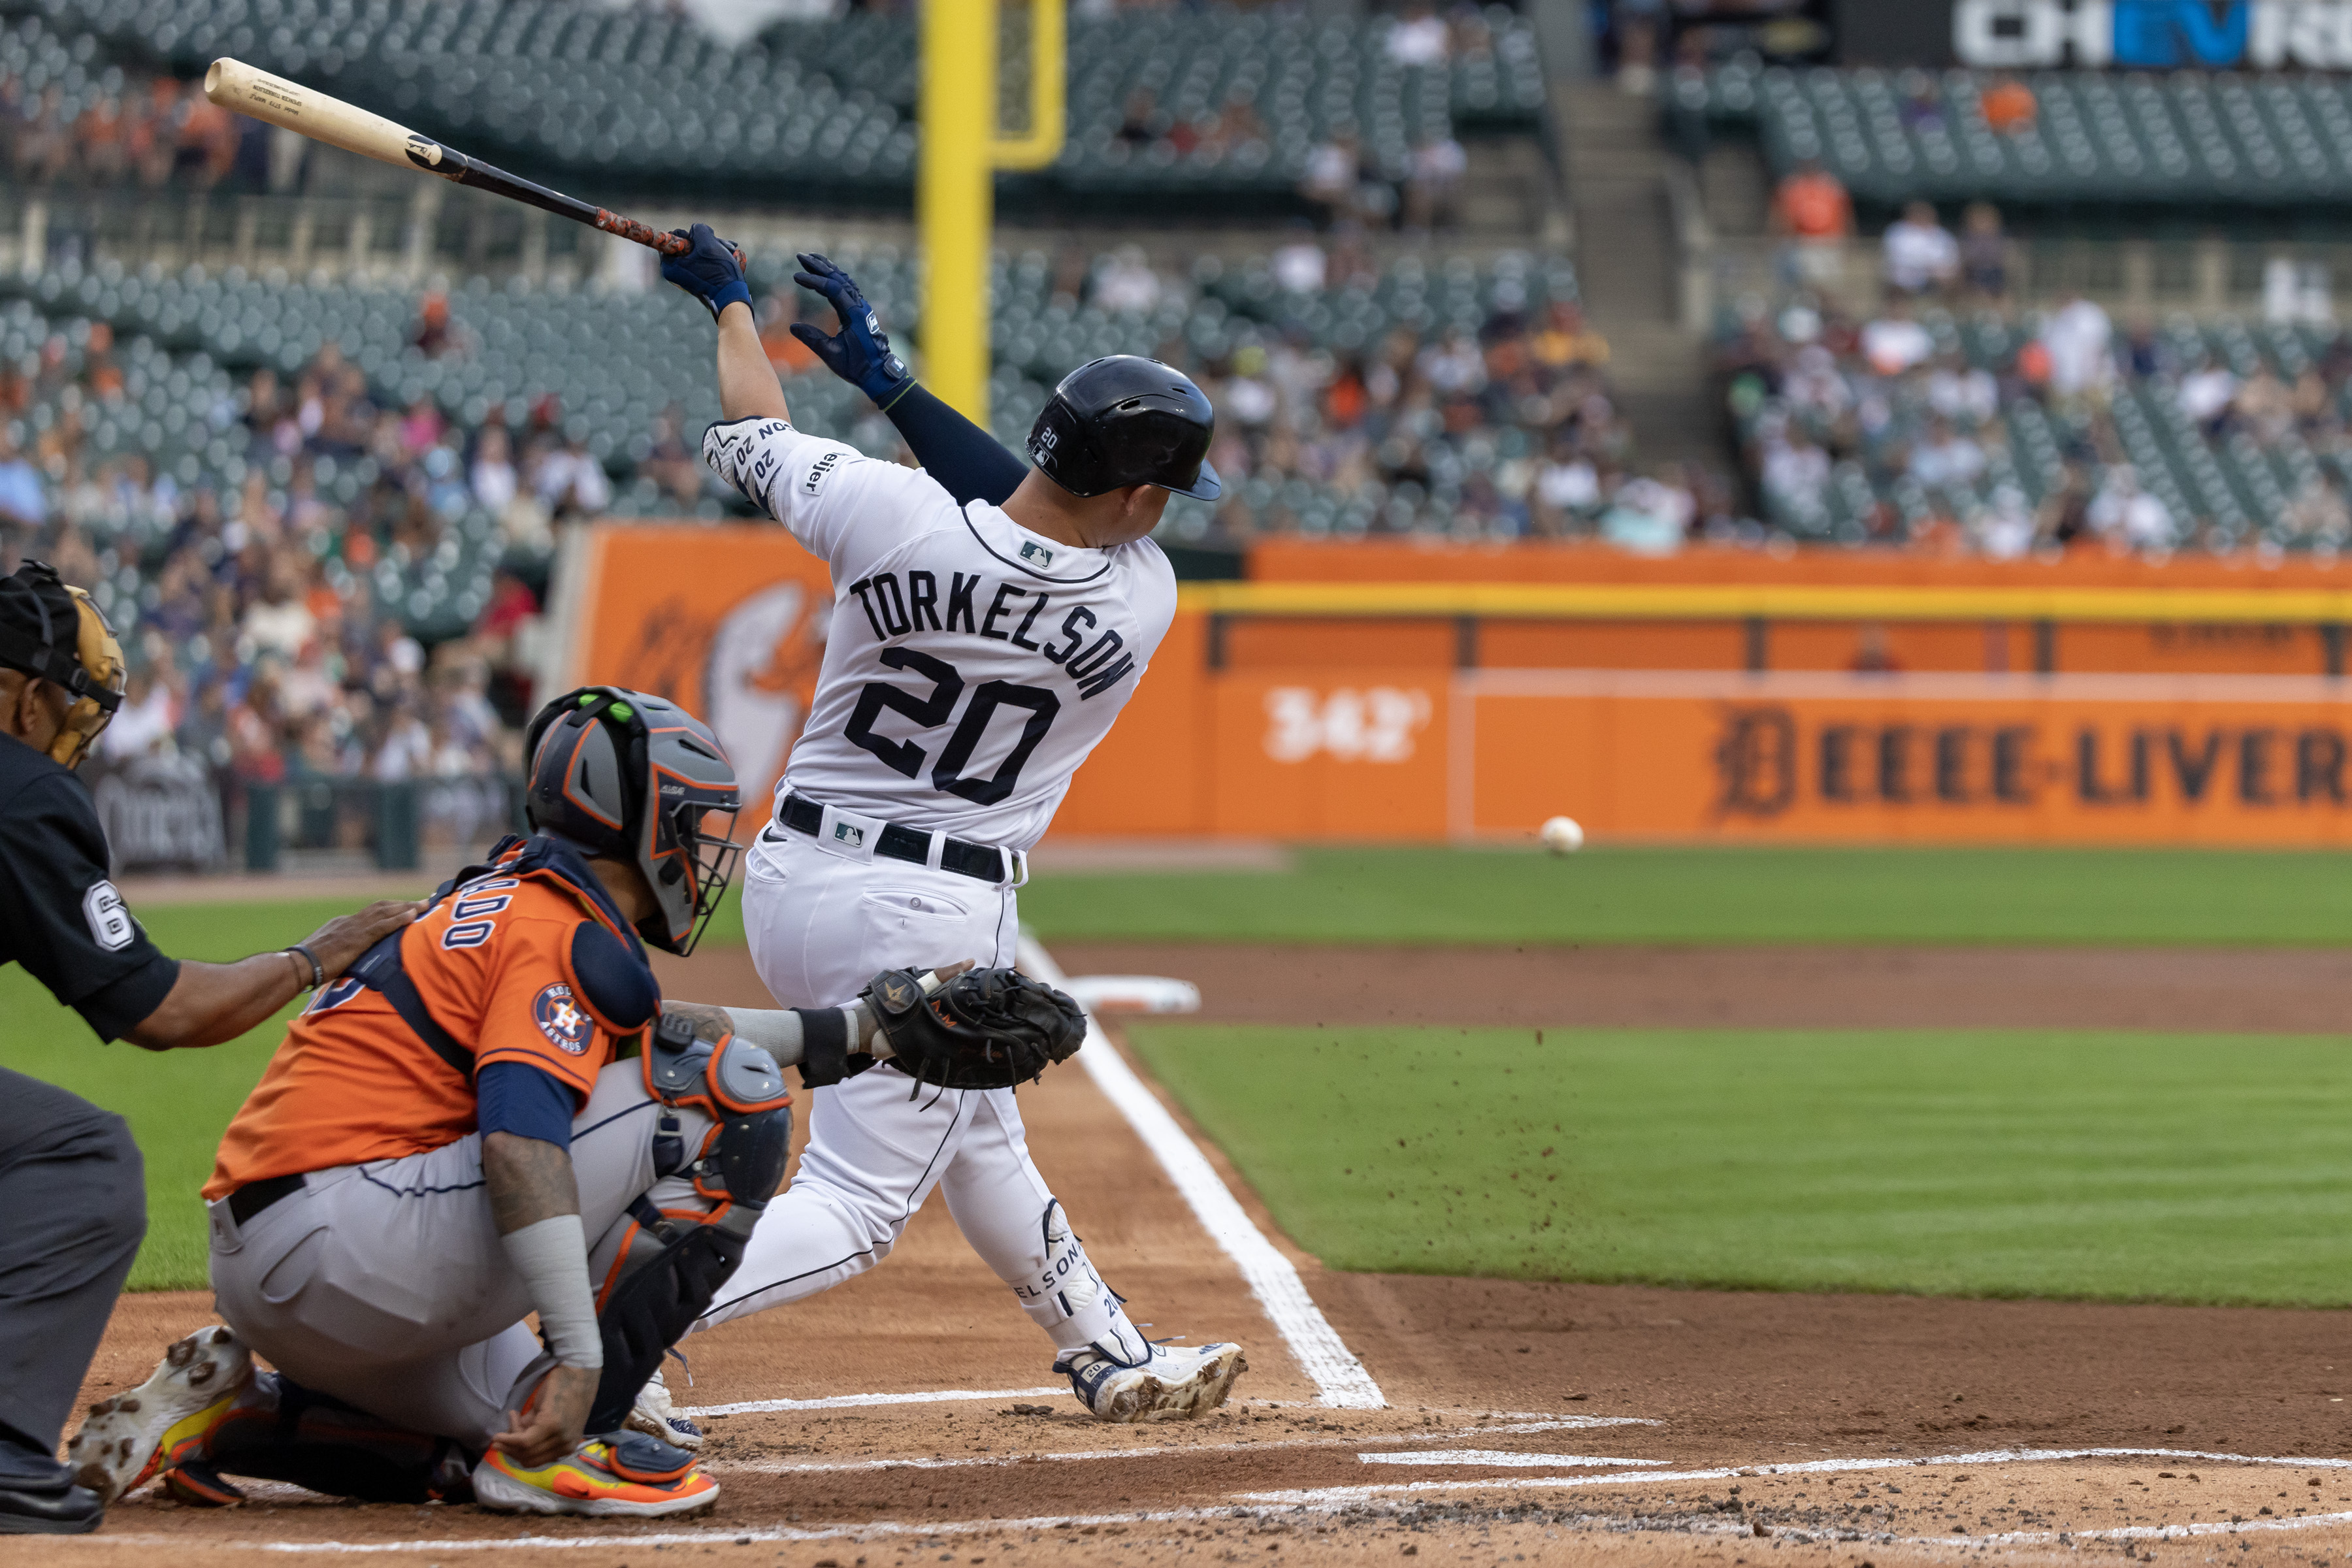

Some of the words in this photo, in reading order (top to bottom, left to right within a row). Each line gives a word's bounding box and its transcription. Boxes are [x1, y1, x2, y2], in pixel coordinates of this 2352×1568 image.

[249, 93, 267, 104] MAPLE
[736, 435, 755, 466] 20
[1041, 427, 1058, 449] 20
[755, 449, 775, 480] 20
[806, 451, 840, 492] eijer
[849, 570, 1135, 702] TORKELSON
[843, 646, 1062, 807] 20
[82, 879, 135, 952] 6
[539, 1021, 581, 1051] ASTROS
[1103, 1294, 1119, 1318] 20
[1086, 1364, 1102, 1377] 20
